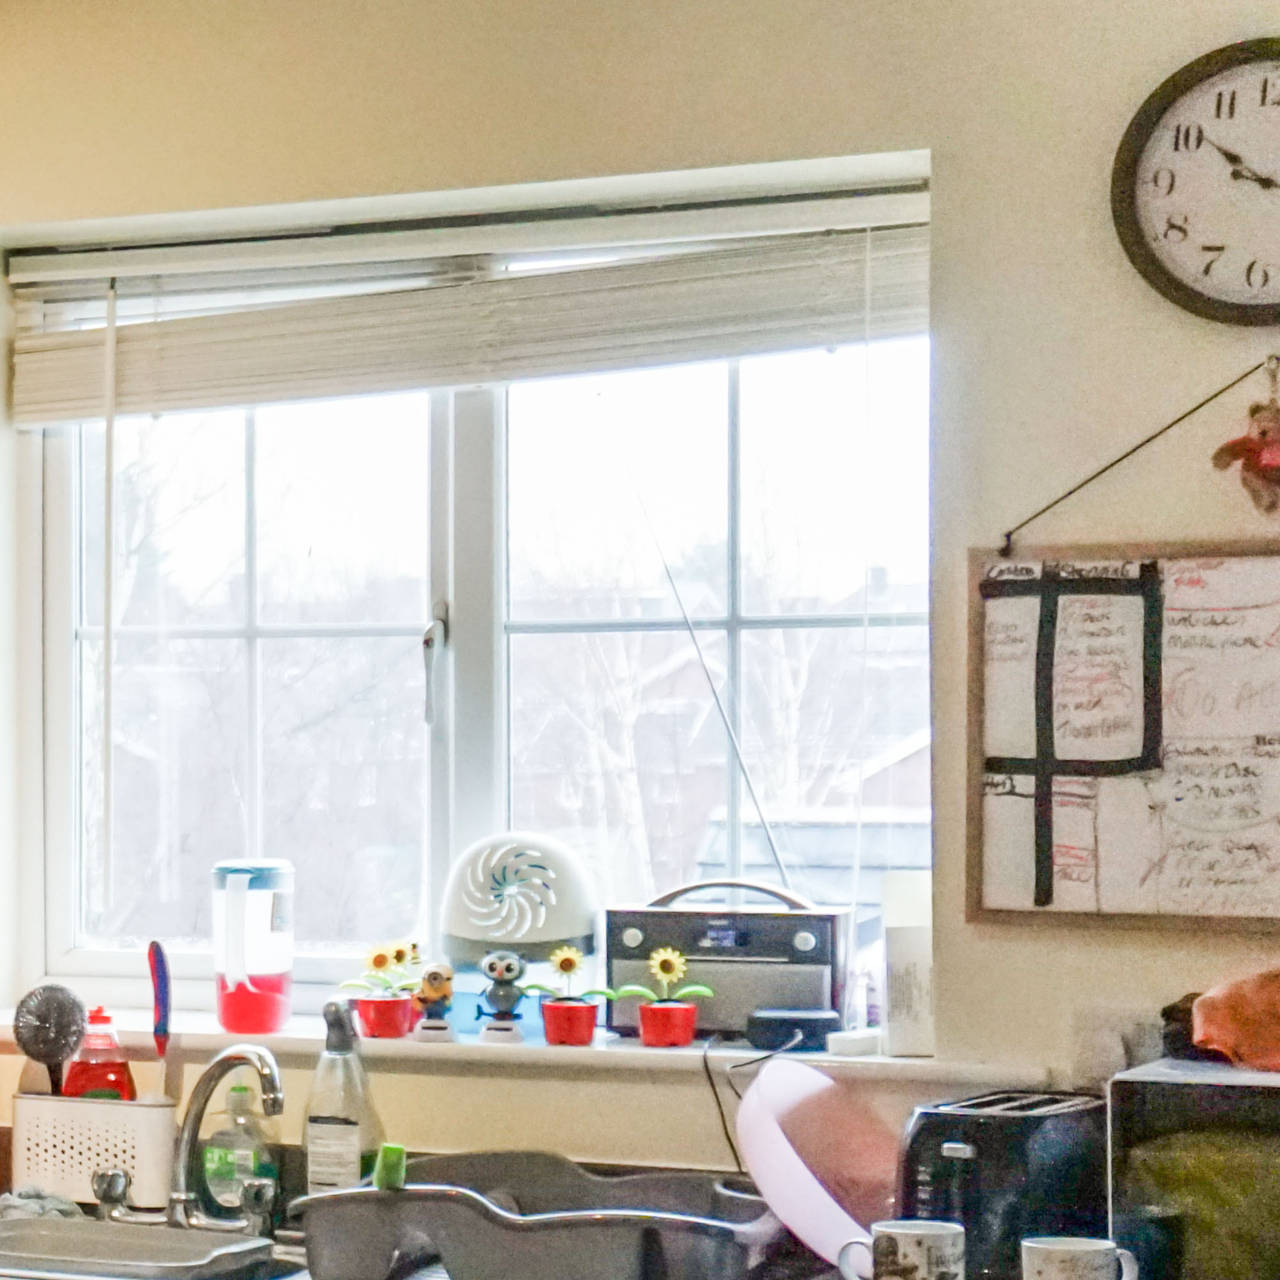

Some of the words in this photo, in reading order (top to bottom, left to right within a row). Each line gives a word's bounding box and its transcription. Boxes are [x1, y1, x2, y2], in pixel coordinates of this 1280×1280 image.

[1215, 89, 1236, 120] 11
[1173, 123, 1204, 152] 10
[1152, 167, 1176, 196] 9
[1163, 213, 1188, 243] 8
[1200, 246, 1225, 276] 7
[1245, 260, 1269, 289] 6
